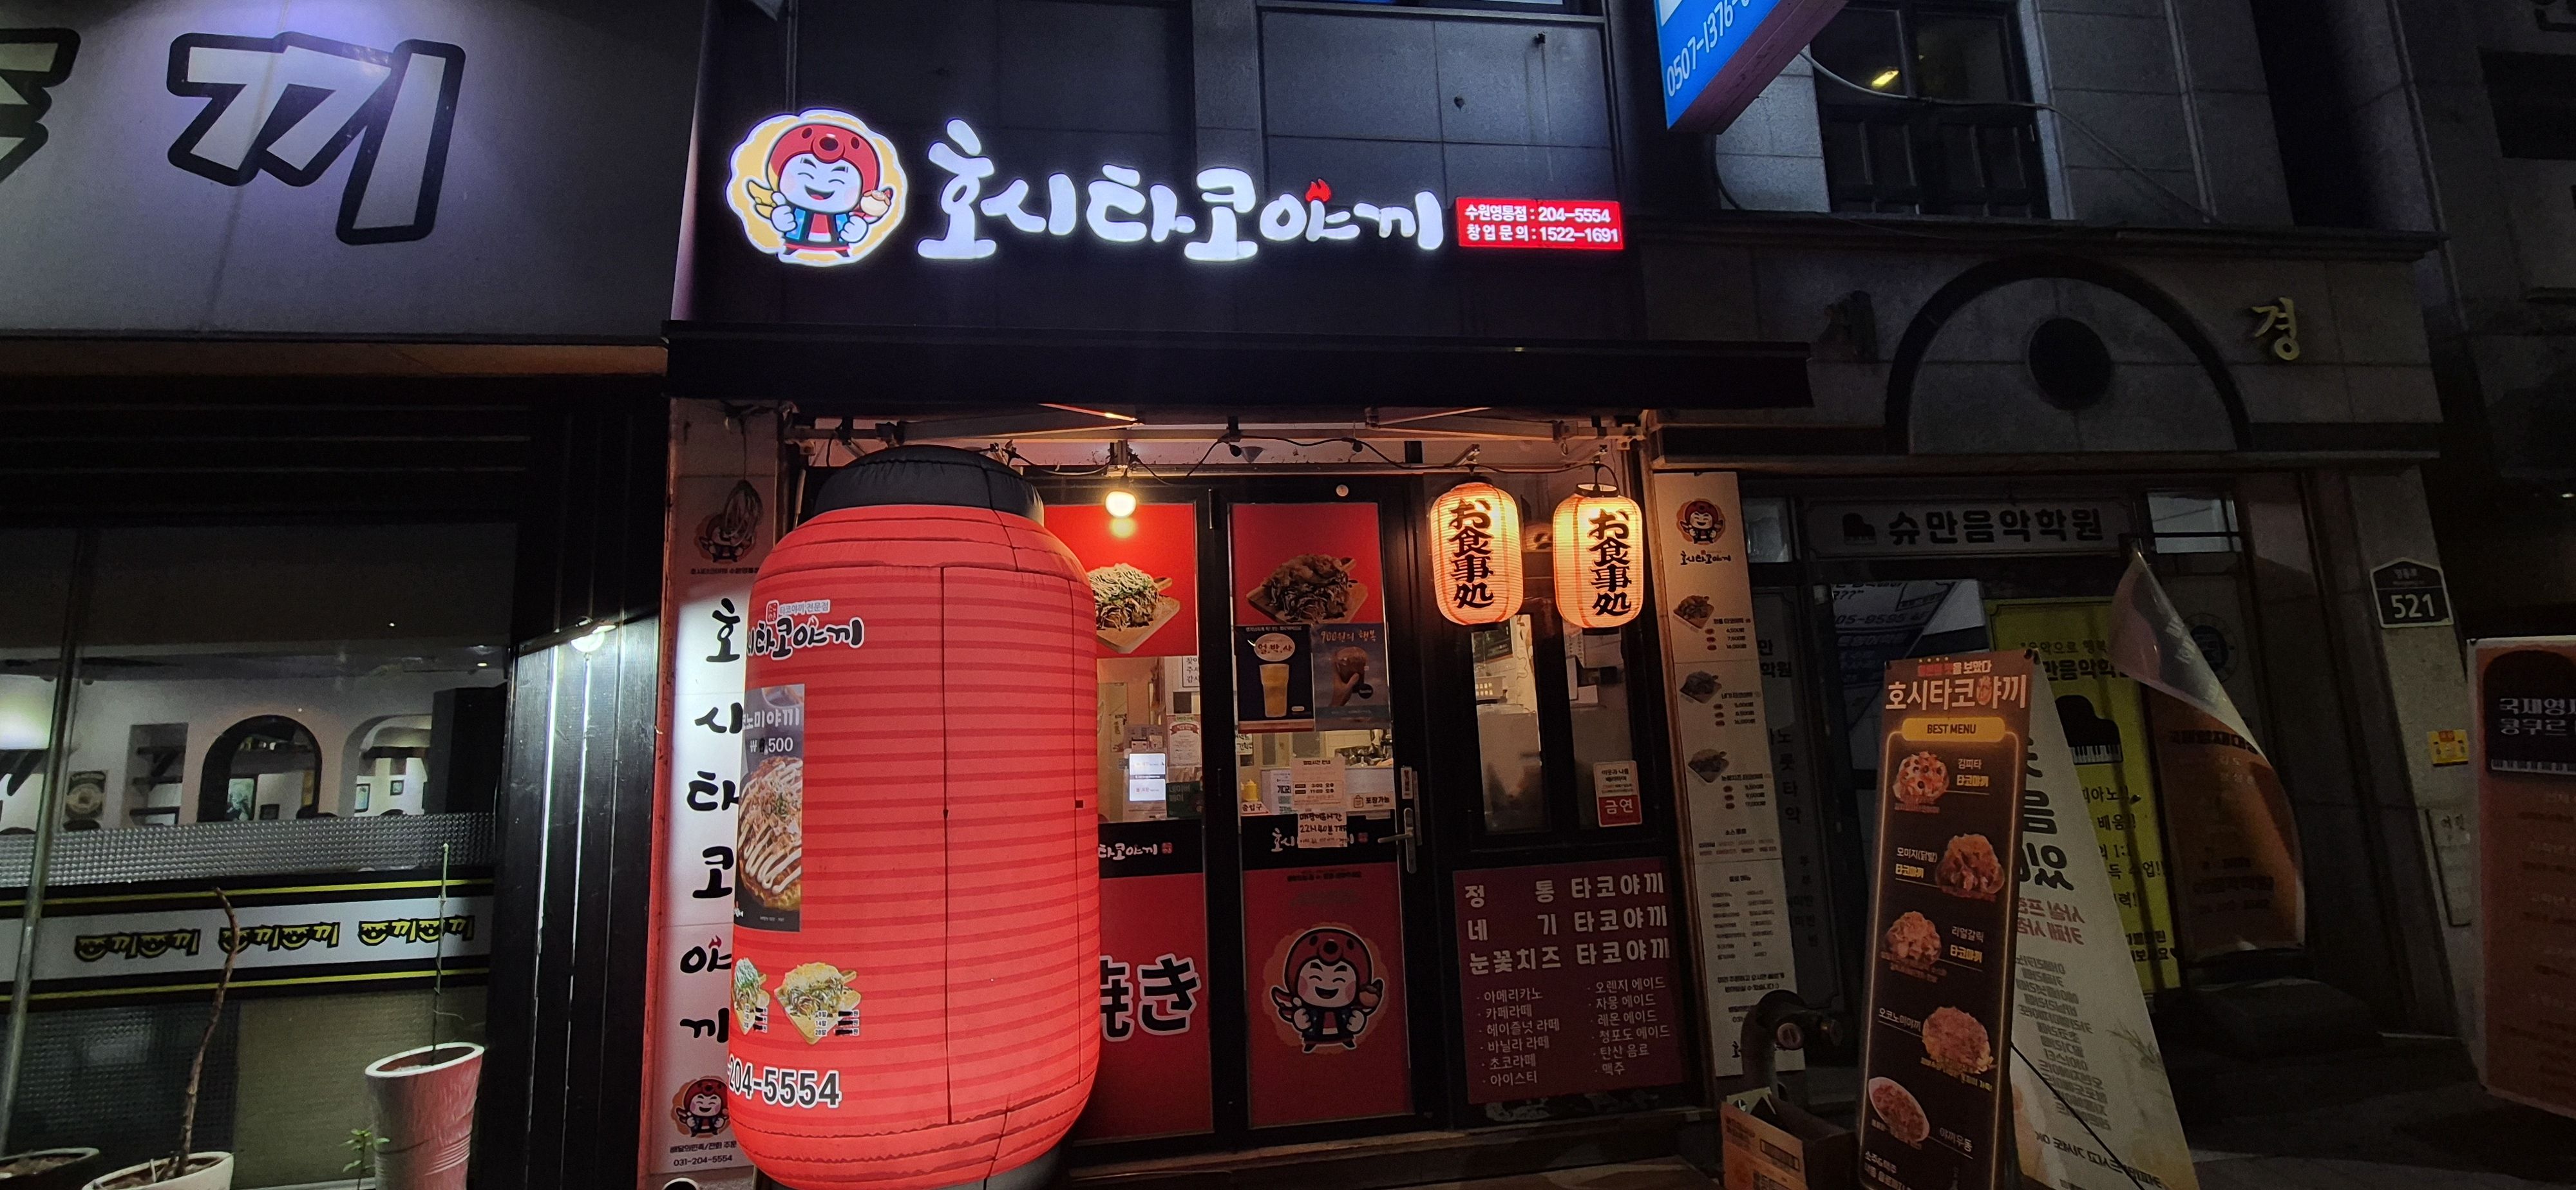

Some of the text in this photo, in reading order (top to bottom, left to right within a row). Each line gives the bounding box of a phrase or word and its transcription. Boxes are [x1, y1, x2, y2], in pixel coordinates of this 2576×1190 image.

[0, 27, 466, 245] 끼
[917, 118, 1444, 262] 호시타코야끼
[1464, 204, 1528, 223] 수원영통점
[1538, 207, 1611, 224] 204-5554
[1539, 225, 1619, 243] 1522-1691
[2251, 296, 2300, 361] 경
[1888, 508, 2103, 545] 슈만음악학원
[1449, 498, 1494, 609] お食事処
[1587, 508, 1632, 617] お食事処
[806, 601, 829, 613] 전문점
[2390, 593, 2436, 619] 521
[1885, 674, 2027, 711] 호시타코야끼
[1927, 724, 1976, 734] BEST MENU
[1604, 798, 1634, 815] 금연
[1571, 872, 1665, 900] 타코야끼
[1574, 905, 1668, 933] 타코야끼
[1469, 937, 1671, 976] 눈꽃치즈 타코야끼
[1595, 976, 1666, 994] 오렌지 에이드
[1484, 987, 1544, 1003] 아메리카노
[1596, 993, 1656, 1011] 자몽 에이드
[1597, 1009, 1658, 1027] 레몬 에이드
[1486, 1020, 1534, 1037] 헤이즐넛
[1636, 1025, 1671, 1040] 에이드
[1488, 1037, 1523, 1053] 바닐라
[1600, 1043, 1650, 1061] 탄산 음료
[1490, 1070, 1539, 1087] 아이스티
[673, 1154, 733, 1167] 031-204-5554
